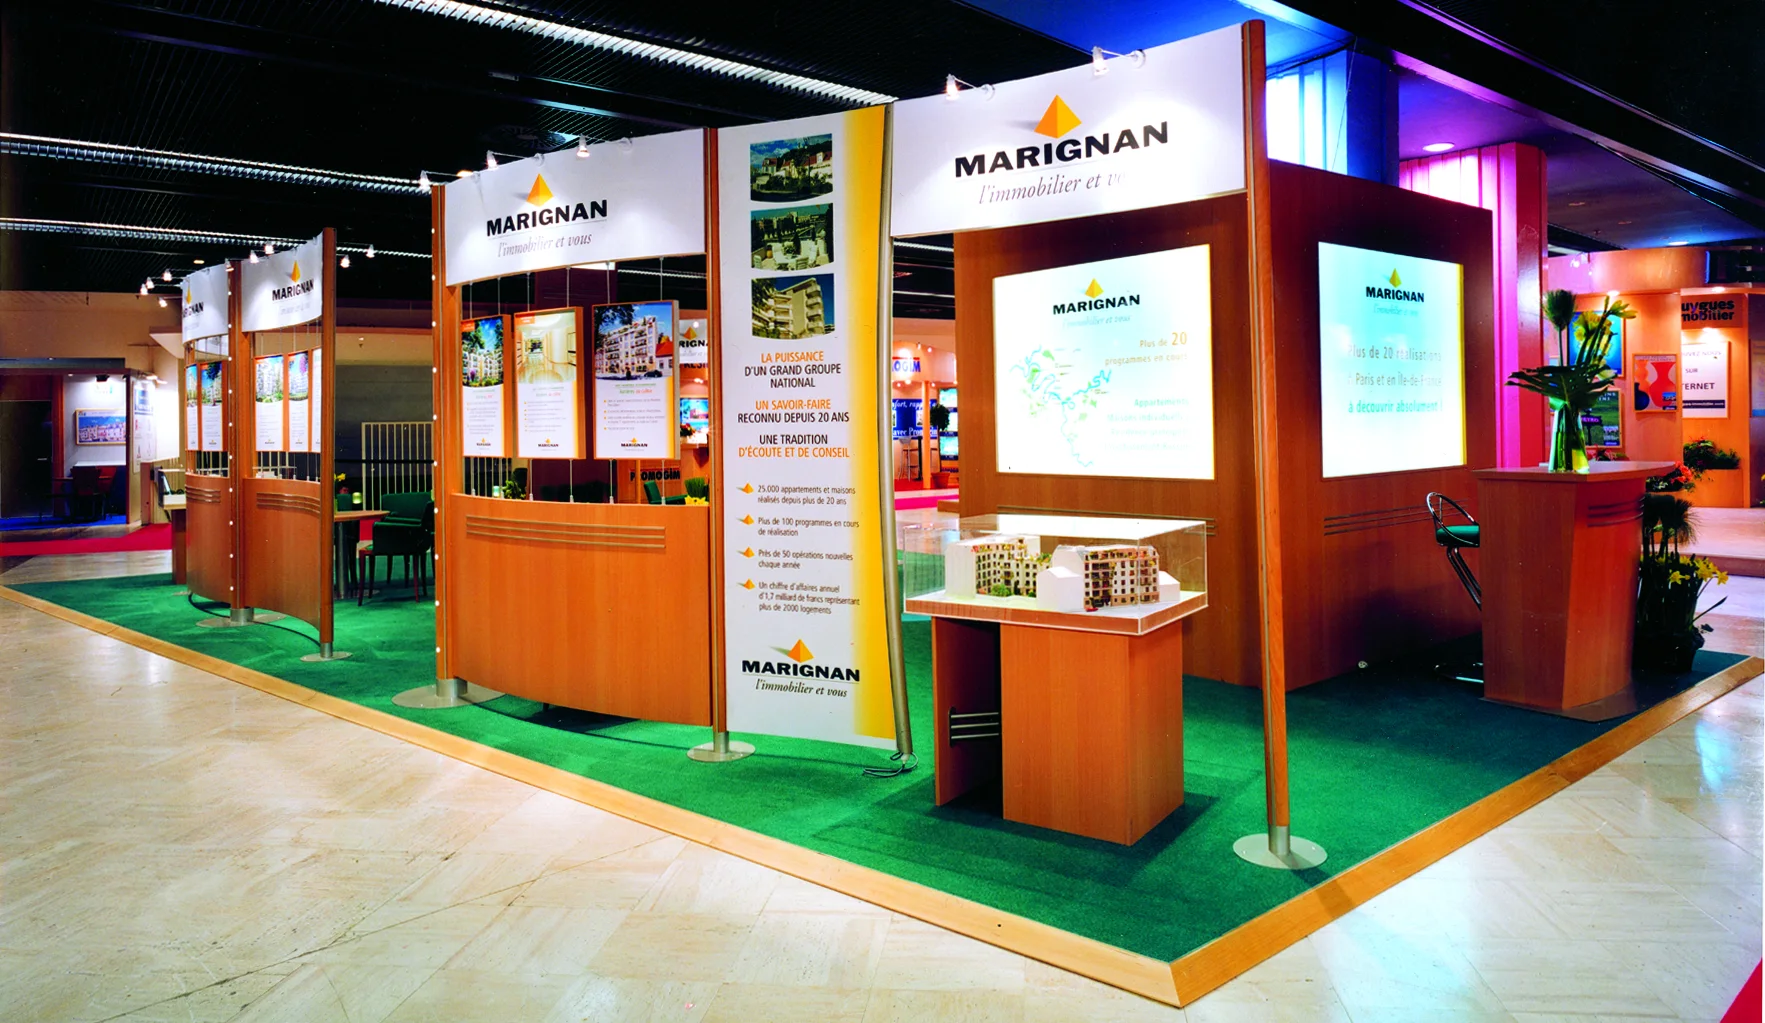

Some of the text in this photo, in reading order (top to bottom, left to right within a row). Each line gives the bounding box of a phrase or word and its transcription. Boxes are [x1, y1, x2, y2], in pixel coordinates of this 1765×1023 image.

[955, 121, 1168, 178] MARIGNAN
[978, 174, 1082, 204] l'immobilier
[1086, 172, 1101, 189] et
[487, 199, 608, 237] MARIGNAN
[555, 237, 564, 248] et
[568, 234, 592, 247] vous
[271, 279, 315, 301] MARIGNAN
[1366, 286, 1425, 303] MARIGNAN
[1053, 294, 1141, 315] MARIGNAN
[1139, 332, 1188, 348] Plus de 20
[761, 351, 824, 364] LA PUISSANCE
[1369, 345, 1380, 359] de
[1383, 346, 1393, 359] 20
[1105, 356, 1151, 366] programmes
[744, 363, 841, 377] D'UN GRAND GROUPE
[770, 378, 816, 388] NATIONAL
[1356, 372, 1375, 386] Paris
[1376, 374, 1385, 386] et
[1387, 376, 1396, 386] en
[755, 399, 831, 411] UN SAVOIR-FAIRE
[737, 412, 850, 423] RECONNU DEPUIS 20 ANS
[759, 434, 828, 445] UNE TRADITION
[738, 446, 850, 458] D'ÉCOUTE ET DE CONSEIL
[758, 485, 780, 493] 25.000
[780, 486, 822, 495] appartements
[831, 486, 856, 495] maisons
[758, 496, 780, 504] réalisés
[781, 497, 802, 505] depuis
[802, 497, 815, 505] plus
[826, 497, 835, 505] 20
[758, 517, 770, 525] Plus
[772, 517, 780, 525] de
[782, 518, 794, 526] 100
[795, 519, 833, 528] programmes
[758, 528, 799, 536] de réalisation
[758, 549, 772, 558] Près
[773, 550, 781, 558] de
[792, 551, 824, 560] opérations
[825, 552, 854, 561] nouvelles
[758, 561, 780, 569] chaque
[759, 581, 840, 593] Un chiffre d'affaires annuel
[775, 593, 797, 601] milliard
[806, 595, 824, 603] francs
[825, 597, 860, 606] représentant
[759, 603, 832, 614] plus de 2000 logements
[741, 660, 860, 682] MARIGNAN
[755, 678, 848, 698] l'immobilier et vous
